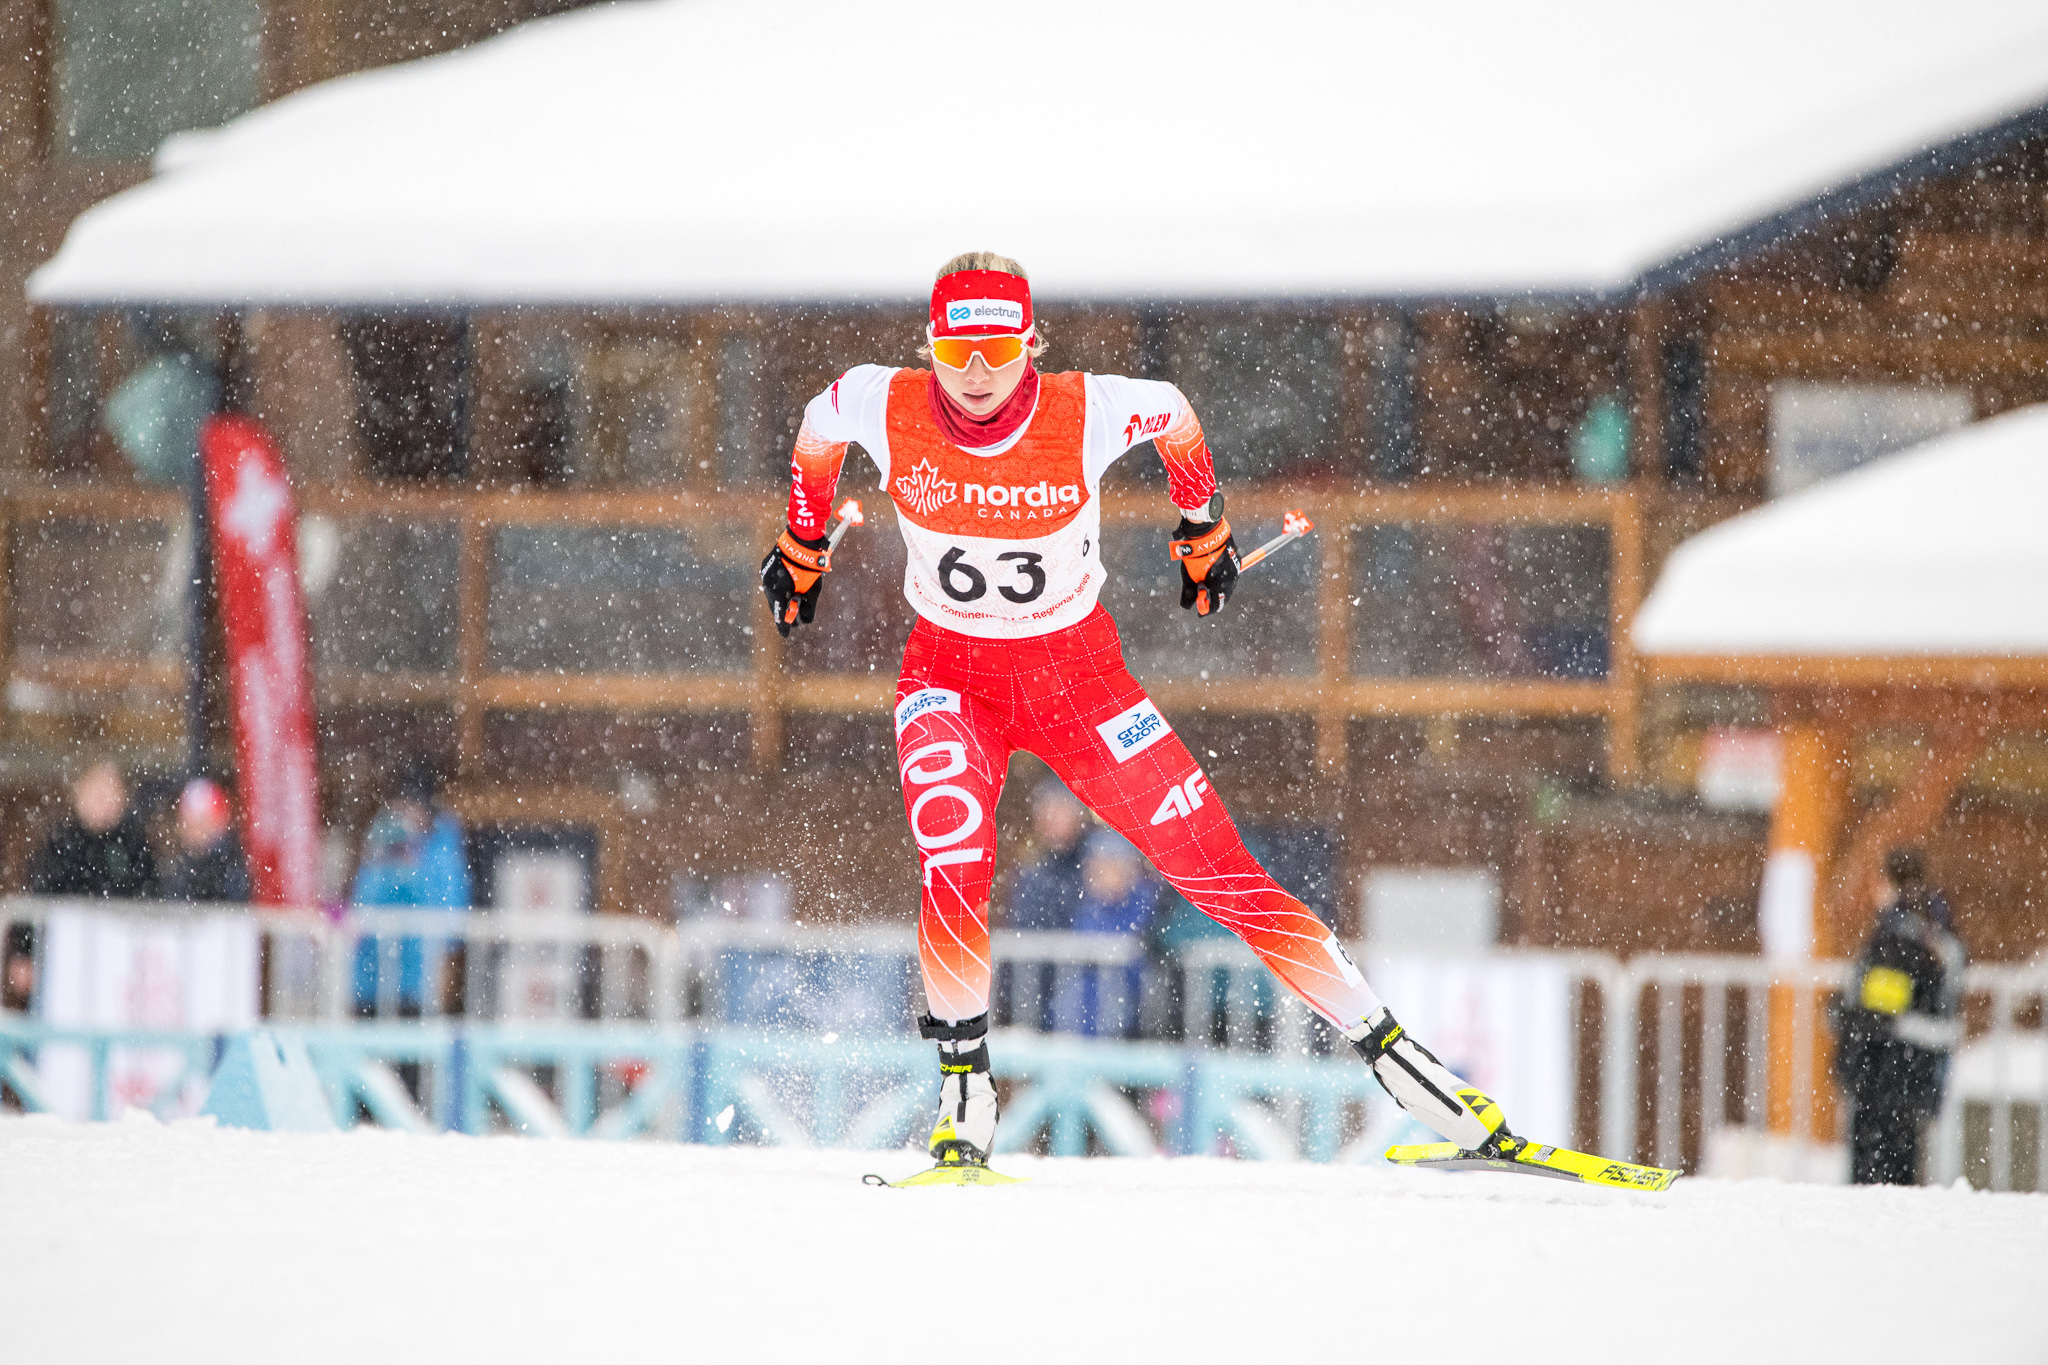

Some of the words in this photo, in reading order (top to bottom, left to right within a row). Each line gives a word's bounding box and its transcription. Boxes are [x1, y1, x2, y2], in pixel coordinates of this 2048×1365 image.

[974, 305, 1021, 320] electrum
[963, 481, 1080, 507] nordiq
[977, 506, 1068, 520] CANADA
[937, 546, 1046, 604] 63
[1032, 593, 1075, 620] Regional
[1149, 767, 1208, 826] 4F
[900, 740, 984, 888] POL
[1597, 1164, 1664, 1187] FISCHER
